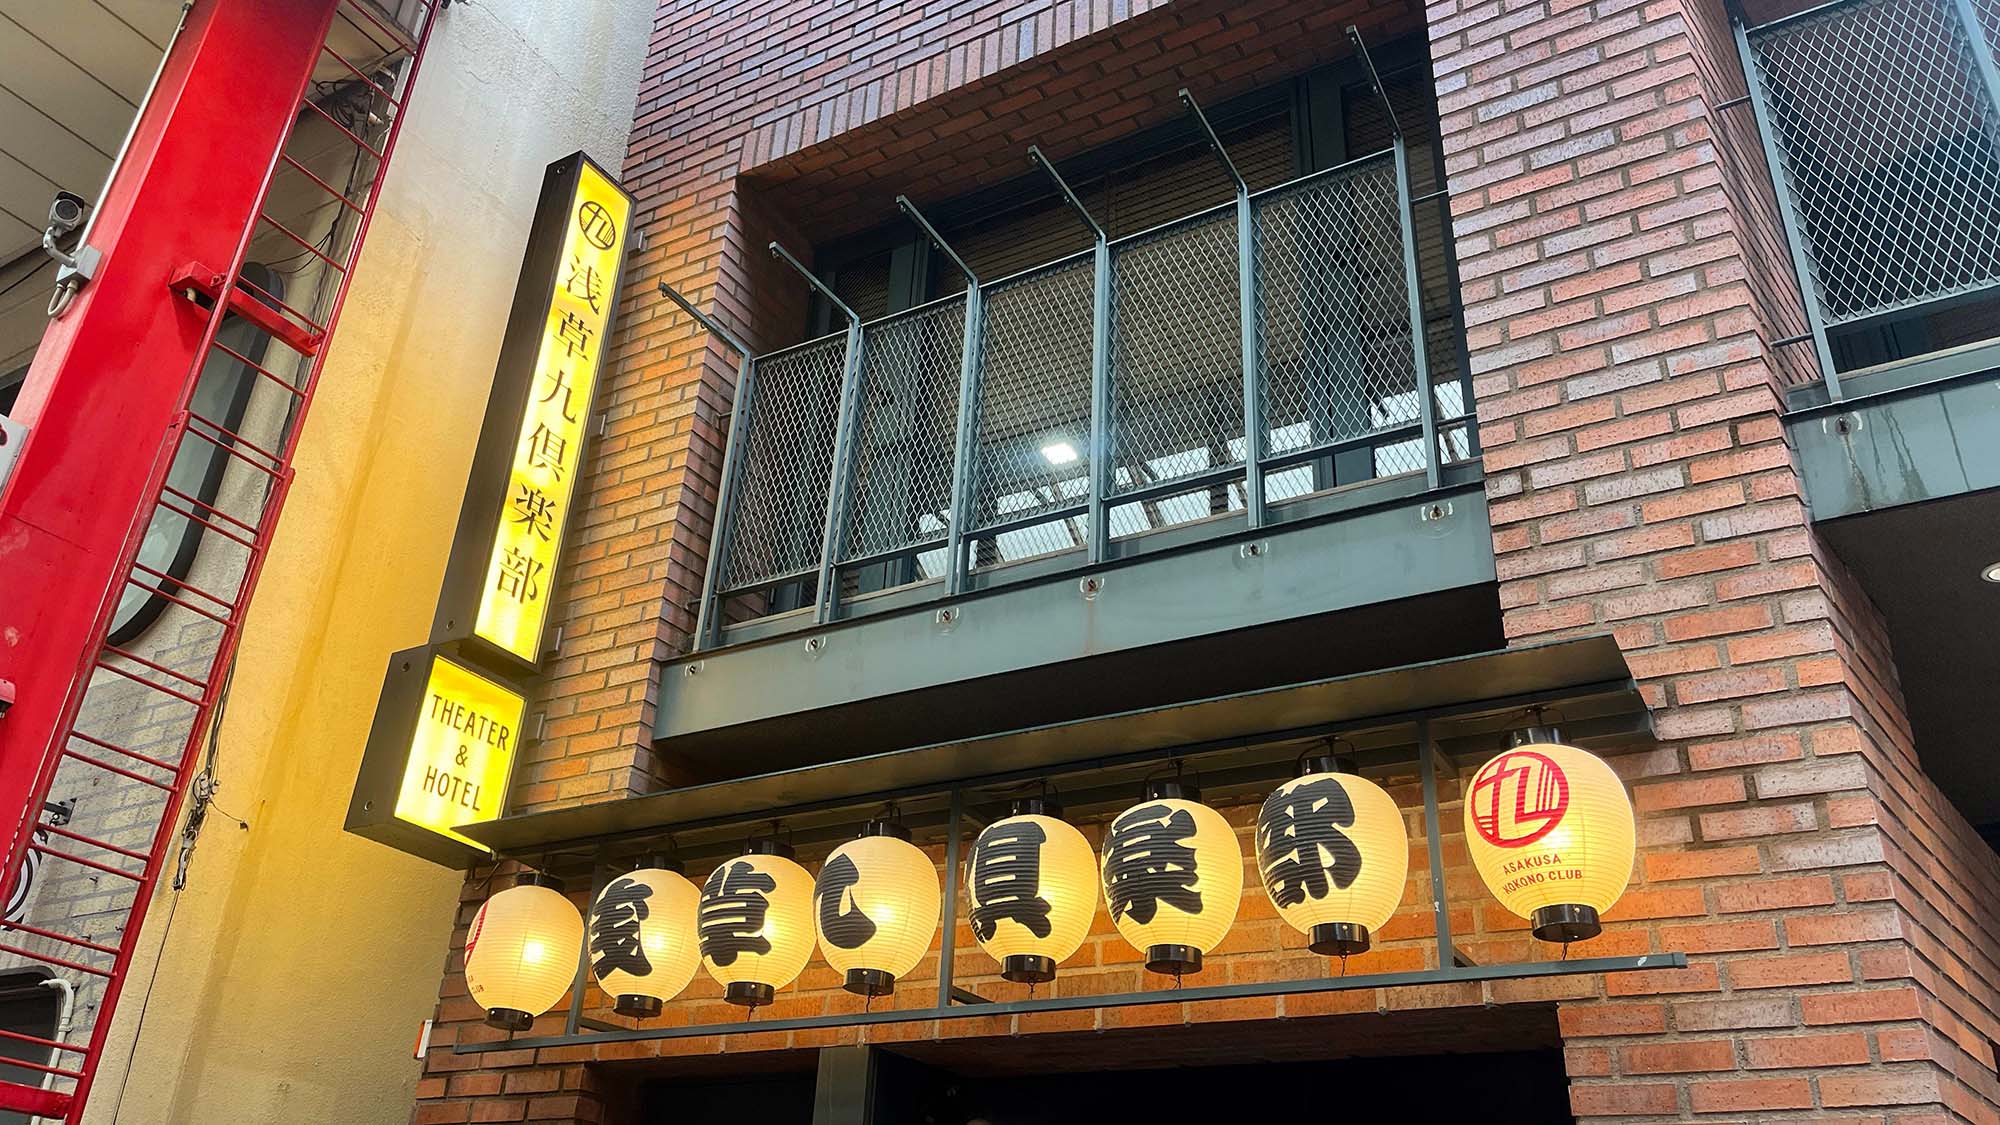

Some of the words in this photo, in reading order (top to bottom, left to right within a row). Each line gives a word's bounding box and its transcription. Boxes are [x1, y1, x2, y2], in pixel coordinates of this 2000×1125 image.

[497, 254, 602, 604] 浅草九倶楽部
[431, 694, 510, 751] THEATER
[455, 744, 468, 768] &
[423, 765, 480, 812] HOTEL
[1502, 853, 1562, 876] ASAKUSA
[1502, 872, 1545, 895] KOKONO
[1548, 869, 1583, 881] CLUB
